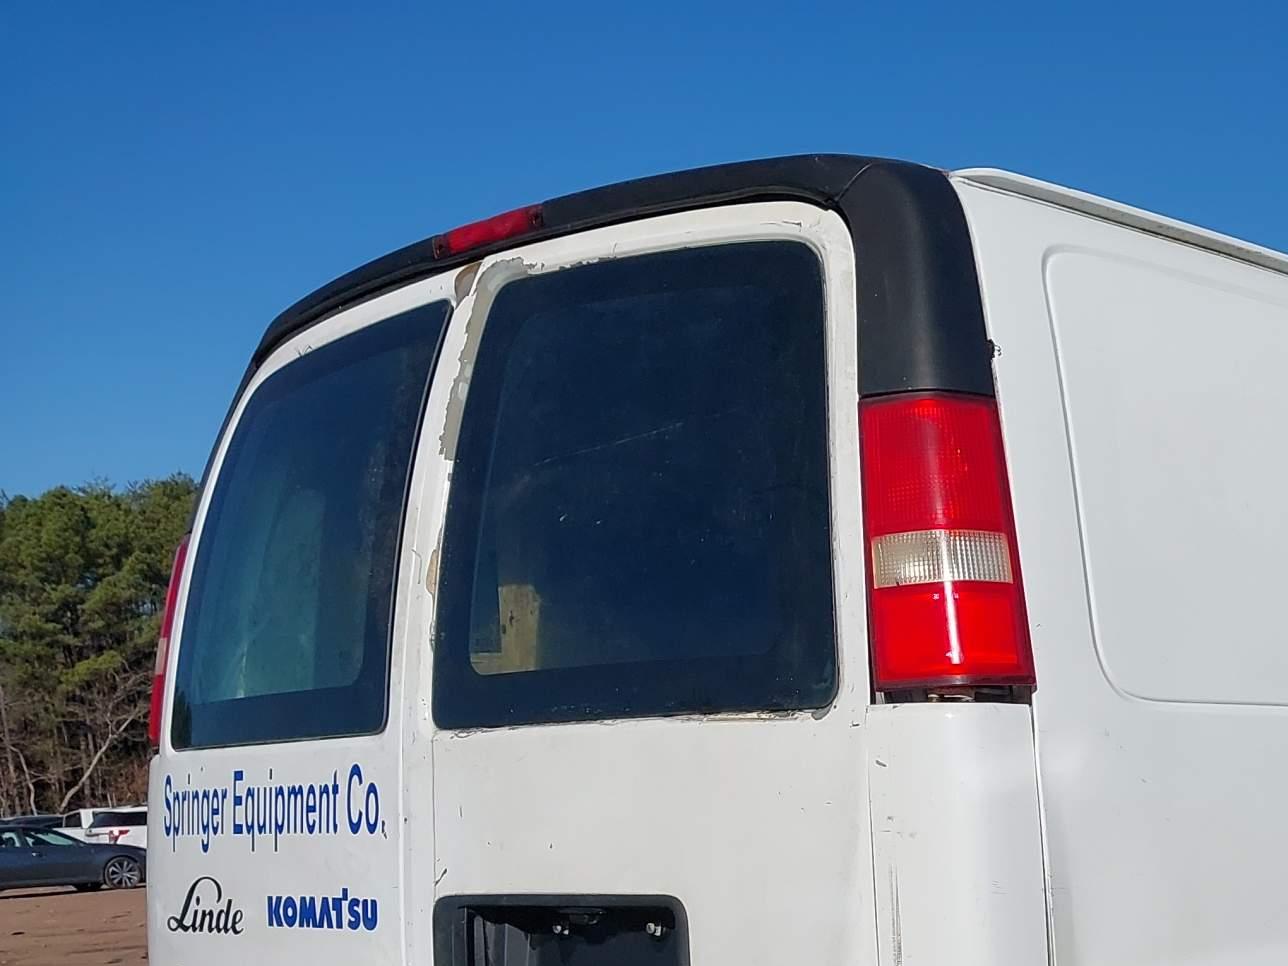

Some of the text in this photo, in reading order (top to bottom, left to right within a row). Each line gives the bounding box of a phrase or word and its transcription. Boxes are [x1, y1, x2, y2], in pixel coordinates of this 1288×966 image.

[164, 773, 227, 853] Springer
[232, 768, 339, 852] Equipment
[167, 876, 244, 935] Linde
[267, 888, 378, 931] KOMATSU
